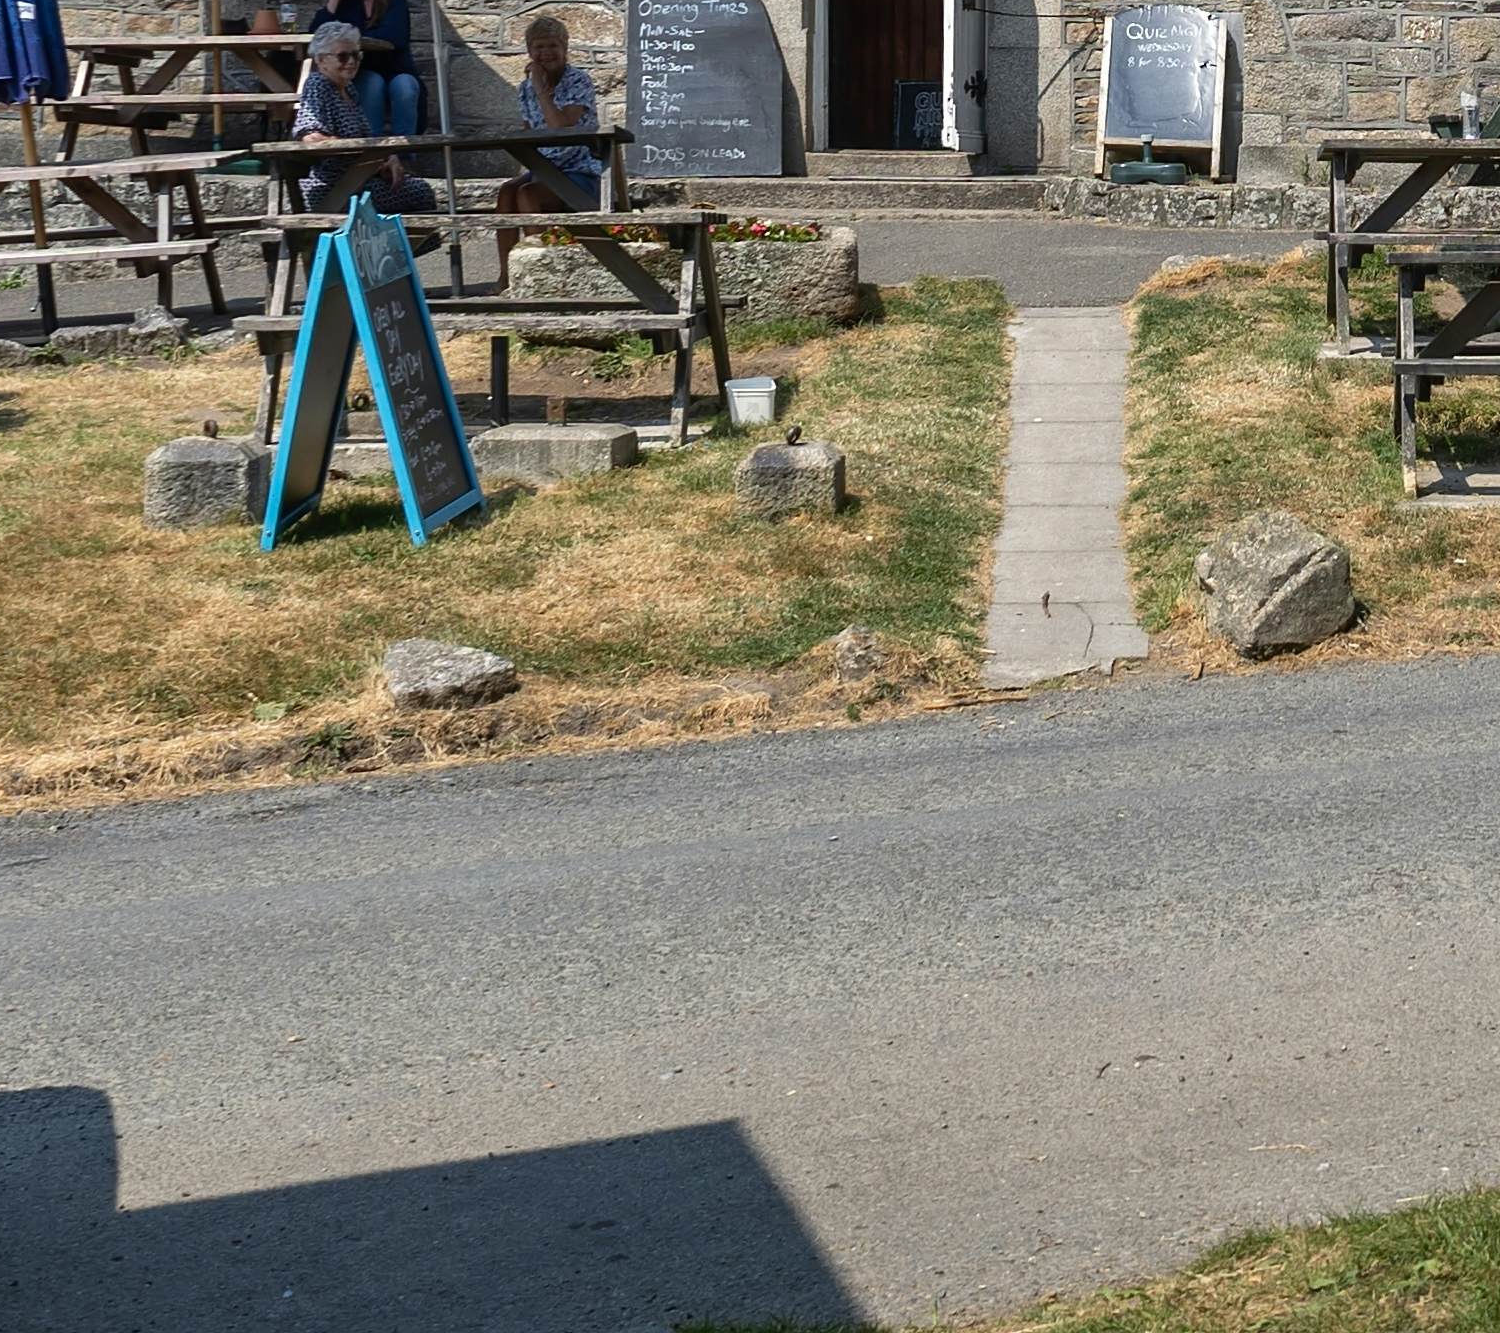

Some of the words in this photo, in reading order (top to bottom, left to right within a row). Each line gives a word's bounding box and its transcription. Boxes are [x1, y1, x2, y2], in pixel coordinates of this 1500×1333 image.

[638, 0, 699, 23] Opening
[1127, 56, 1135, 68] 8
[642, 144, 686, 164] DOGS
